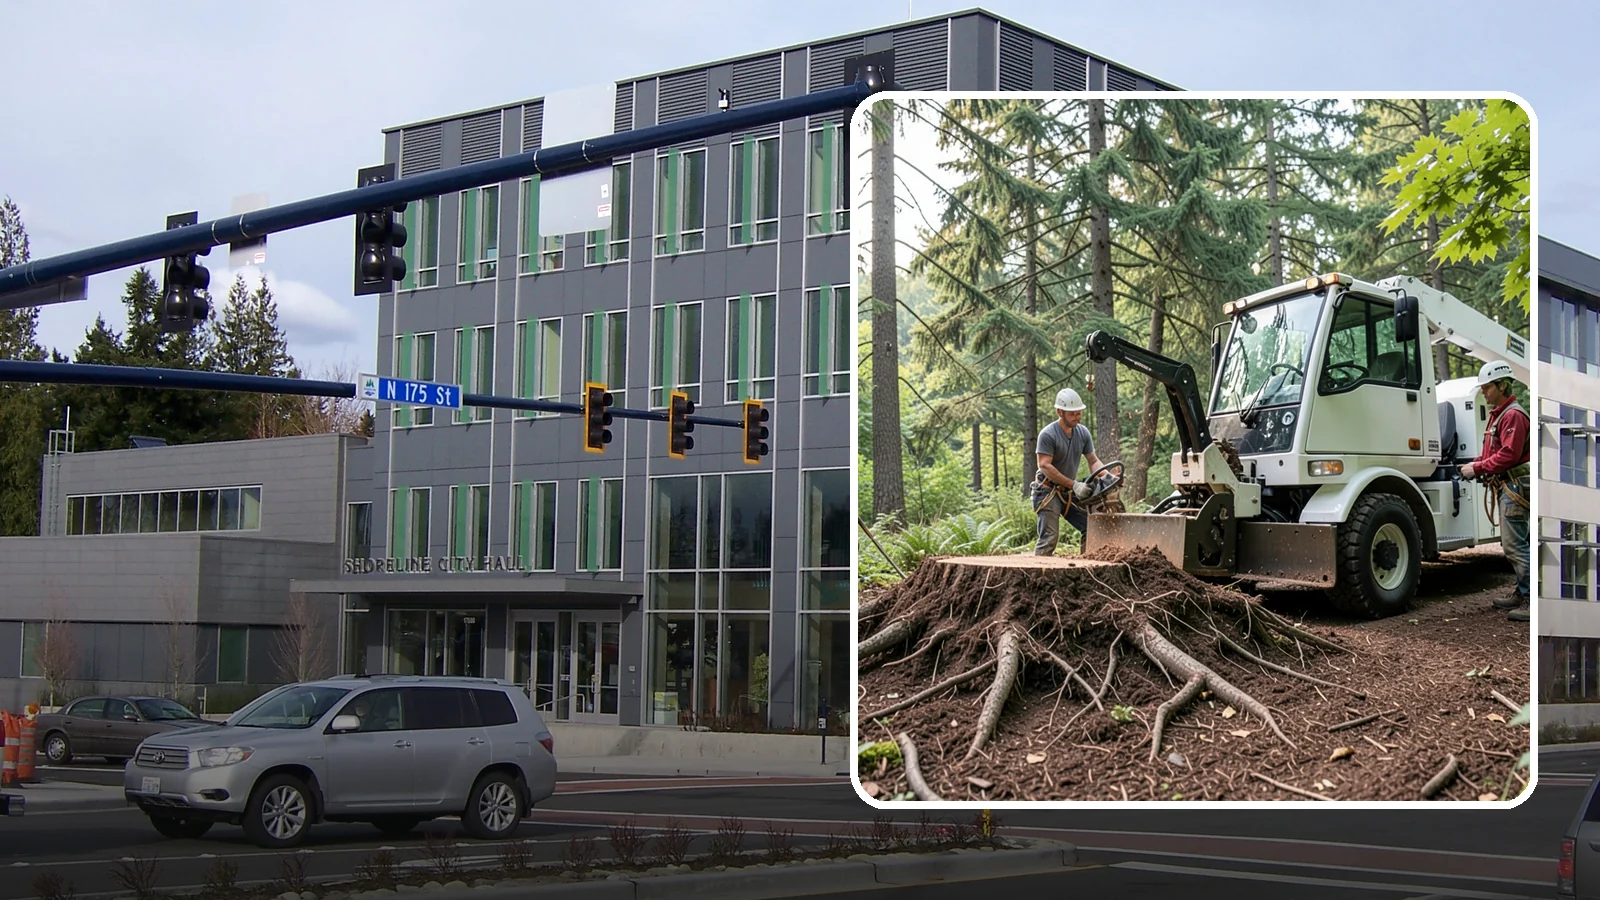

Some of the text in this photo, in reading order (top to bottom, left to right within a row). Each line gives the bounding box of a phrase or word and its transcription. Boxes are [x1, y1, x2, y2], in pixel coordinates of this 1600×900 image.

[387, 380, 451, 406] N 175 St
[344, 555, 525, 573] SHORELINE CITY HALL
